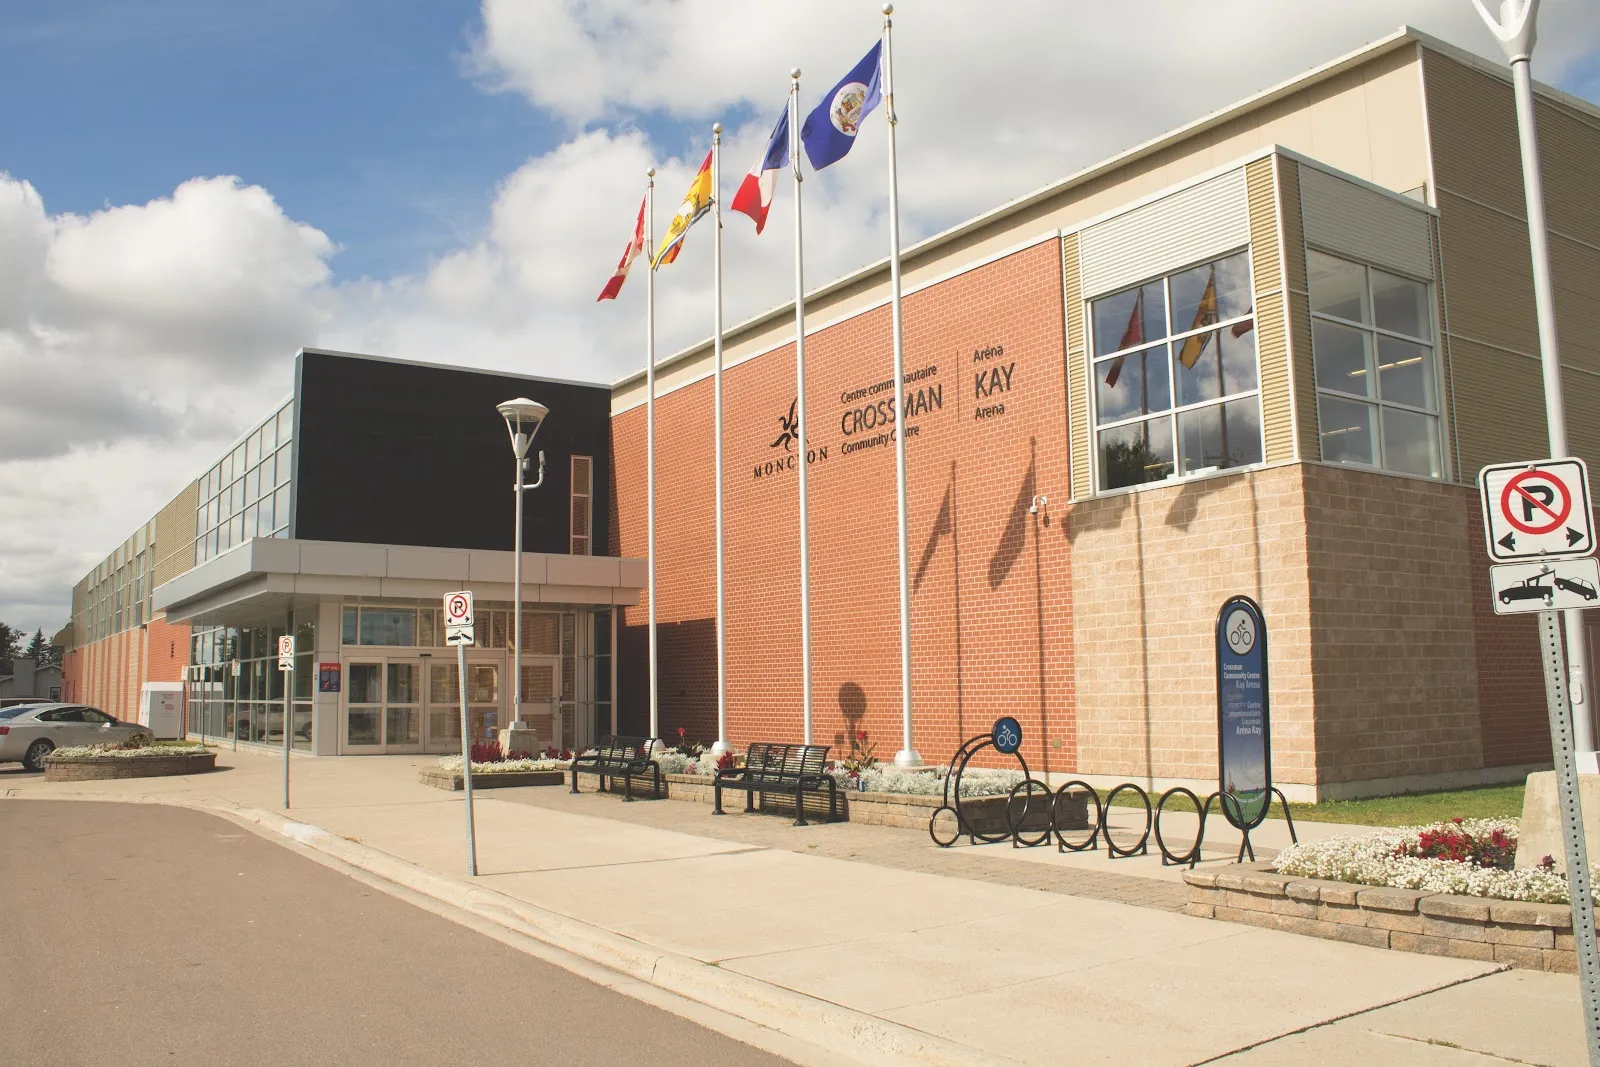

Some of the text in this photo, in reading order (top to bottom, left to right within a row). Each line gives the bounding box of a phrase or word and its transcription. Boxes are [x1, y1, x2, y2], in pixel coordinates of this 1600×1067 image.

[973, 345, 1004, 363] Aréna
[840, 365, 937, 404] Centre commautaire
[975, 362, 1016, 400] KAY
[974, 403, 1005, 421] Arena
[841, 425, 920, 455] Community Ctre
[753, 446, 829, 479] MONCON
[1223, 672, 1247, 680] Community
[1235, 680, 1261, 690] Kay Arena
[1246, 701, 1261, 709] Centre
[1251, 726, 1262, 735] Kay
